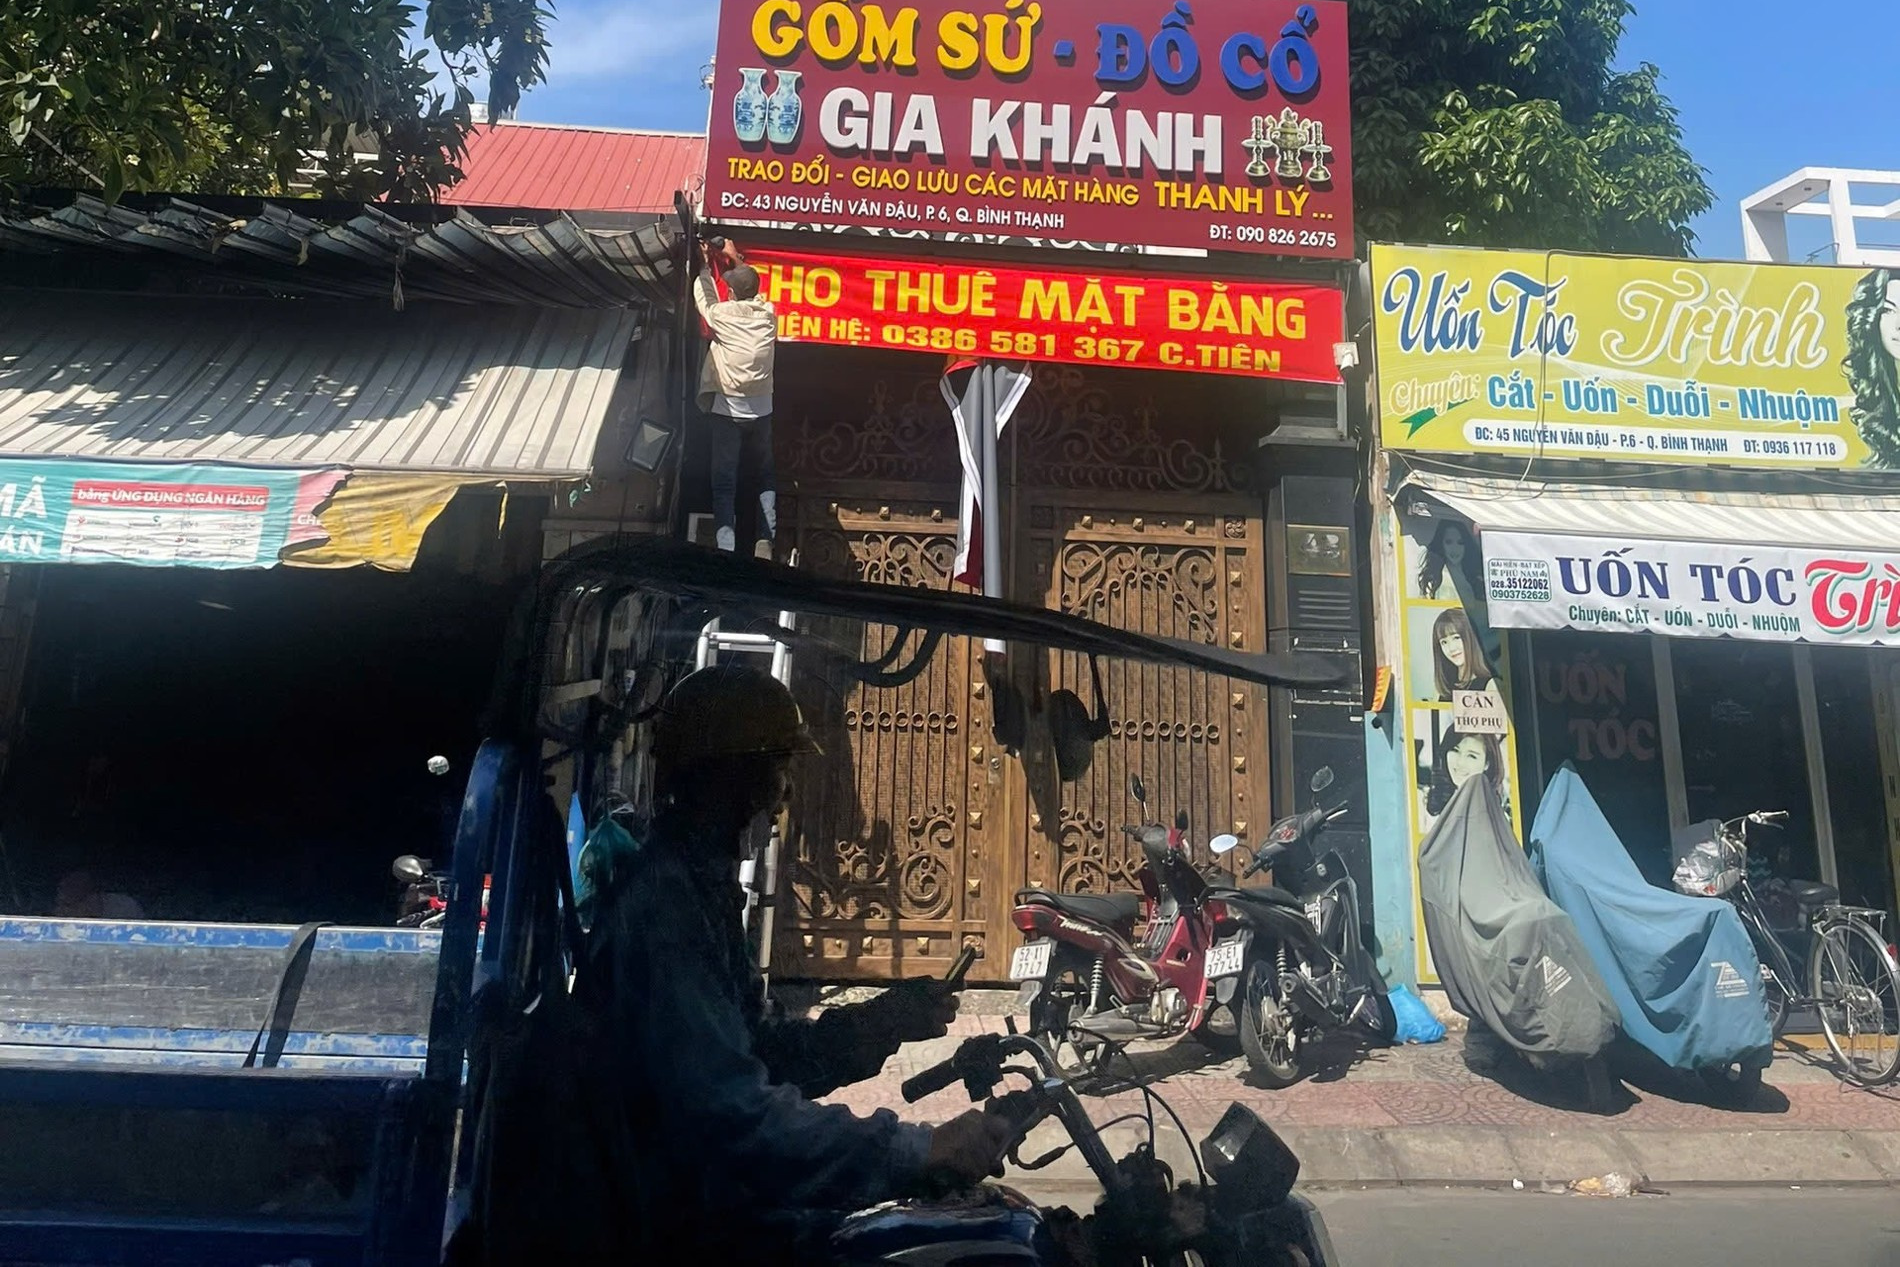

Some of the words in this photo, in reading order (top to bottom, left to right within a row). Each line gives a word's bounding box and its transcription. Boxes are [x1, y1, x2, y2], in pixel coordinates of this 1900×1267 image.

[1094, 0, 1200, 87] ĐỒ
[1220, 4, 1321, 96] CỔ
[818, 86, 945, 157] GIA
[969, 90, 1223, 175] KHÁNH
[721, 192, 749, 209] ĐC:
[752, 194, 771, 209] 43
[774, 192, 843, 215] NGUYỄN
[847, 200, 881, 217] VĂN
[885, 200, 921, 221] ĐẬU,
[956, 209, 972, 223] Q.
[977, 205, 1011, 225] BÌNH
[1014, 211, 1064, 230] THẠNH
[728, 157, 784, 182] TRAO
[791, 154, 830, 185] ĐỔI
[852, 165, 910, 191] GIAO
[916, 169, 959, 194] LƯU
[965, 171, 1016, 198] CÁC
[1022, 175, 1069, 204] MẶT
[1074, 177, 1140, 206] HÀNG
[1154, 181, 1263, 214] THANH
[1209, 224, 1232, 240] ĐT:
[1236, 226, 1264, 242] 090
[1268, 228, 1296, 245] 826
[1299, 230, 1337, 248] 2675
[866, 269, 997, 317] THUÊ
[1018, 274, 1145, 334] MẶT
[1168, 282, 1307, 340] BẰNG
[1382, 267, 1484, 354] Uốn
[1489, 269, 1579, 360] Tóc
[1600, 268, 1830, 369] Trình
[777, 311, 821, 337] IÊN
[829, 318, 871, 345] HỆ:
[882, 324, 977, 351] 0386
[990, 331, 1056, 356] 581
[1073, 337, 1144, 362] 367
[1159, 341, 1281, 372] C.TIÊN
[1390, 371, 1481, 416] Chuyên:
[1487, 371, 1536, 410] Cắt
[1562, 377, 1618, 413] Uốn
[1646, 380, 1711, 418] Duỗi
[1738, 388, 1839, 428] Nhuộm
[1475, 427, 1493, 441] ĐC:
[1496, 428, 1509, 441] 45
[1514, 424, 1558, 444] NGUYỄN
[1560, 428, 1583, 444] VĂN
[1586, 430, 1609, 449] ĐẬU
[1620, 434, 1636, 448] P.6
[1647, 436, 1658, 450] Q.
[1661, 433, 1688, 451] BÌNH
[1691, 437, 1728, 455] THẠNH
[1743, 439, 1760, 453] ĐT:
[1763, 440, 1789, 454] 0936
[1793, 441, 1812, 455] 117
[1816, 442, 1836, 456] 118
[1492, 589, 1549, 600] 0903752628
[1555, 547, 1670, 600] UỐN
[1689, 557, 1796, 606] TÓC
[1569, 605, 1621, 624] Chuyên:
[1625, 603, 1650, 624] CẮT
[1664, 605, 1693, 627] UỐN
[1752, 613, 1800, 636] NHUỘM
[1540, 650, 1627, 704] UỐN
[1568, 707, 1656, 761] TÓC
